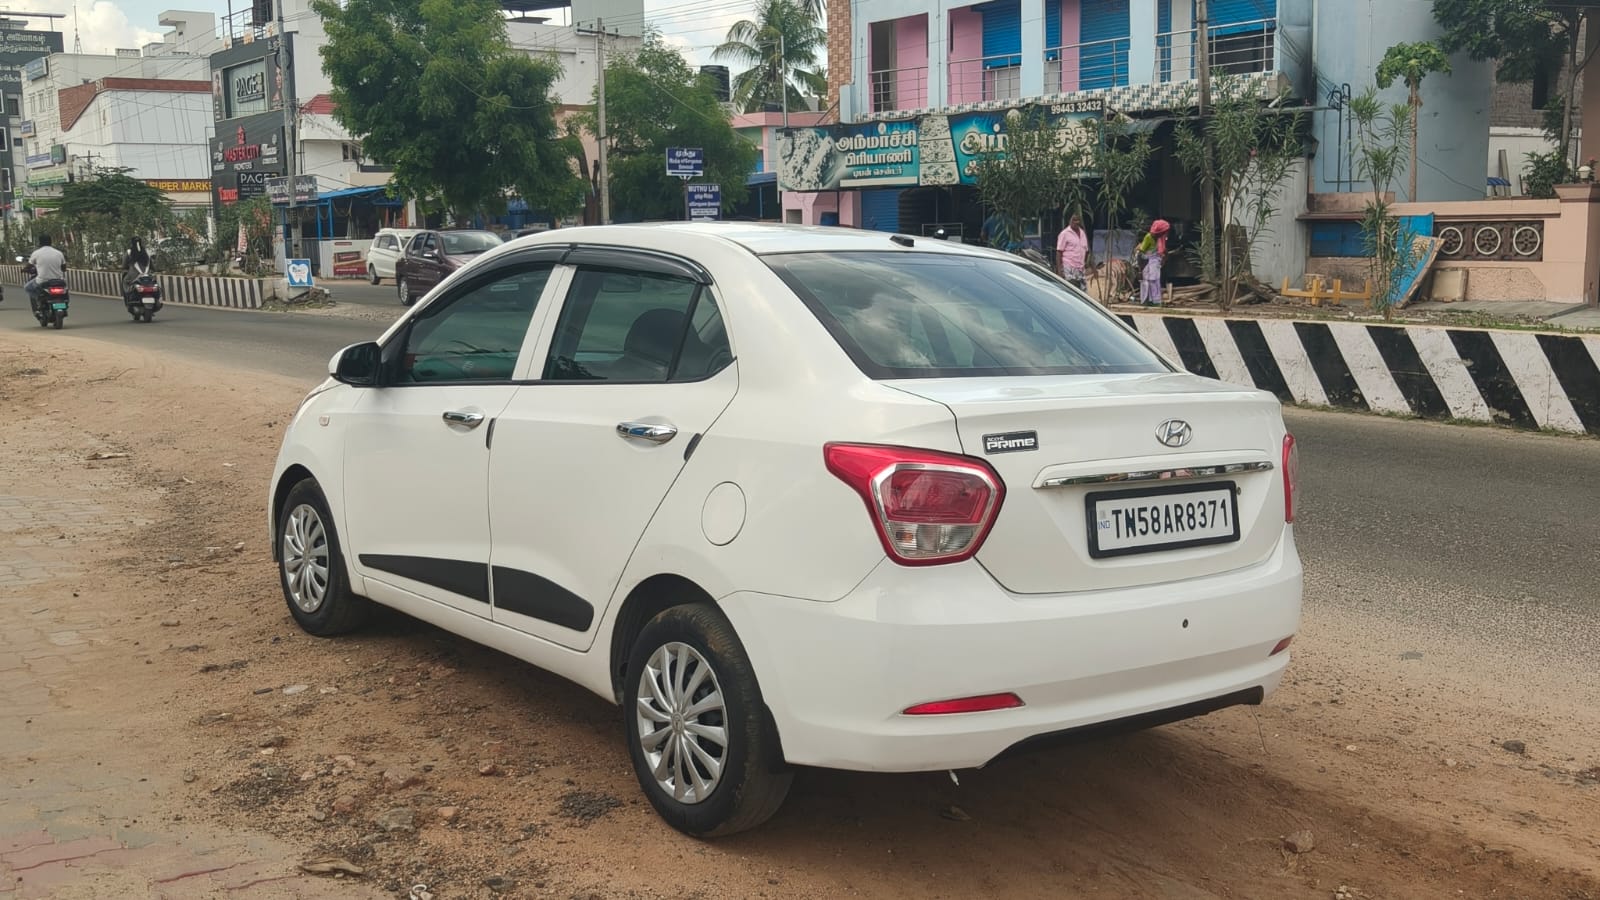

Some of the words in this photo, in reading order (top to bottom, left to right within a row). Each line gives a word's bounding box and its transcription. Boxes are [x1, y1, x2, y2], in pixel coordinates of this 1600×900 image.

[1051, 103, 1075, 115] 99443
[1077, 100, 1102, 112] 32432
[224, 145, 246, 162] MASTER
[246, 143, 260, 159] CITY
[845, 149, 912, 167] பிரியாணி
[150, 181, 178, 191] SUPER
[1112, 499, 1228, 539] TN58AR8371
